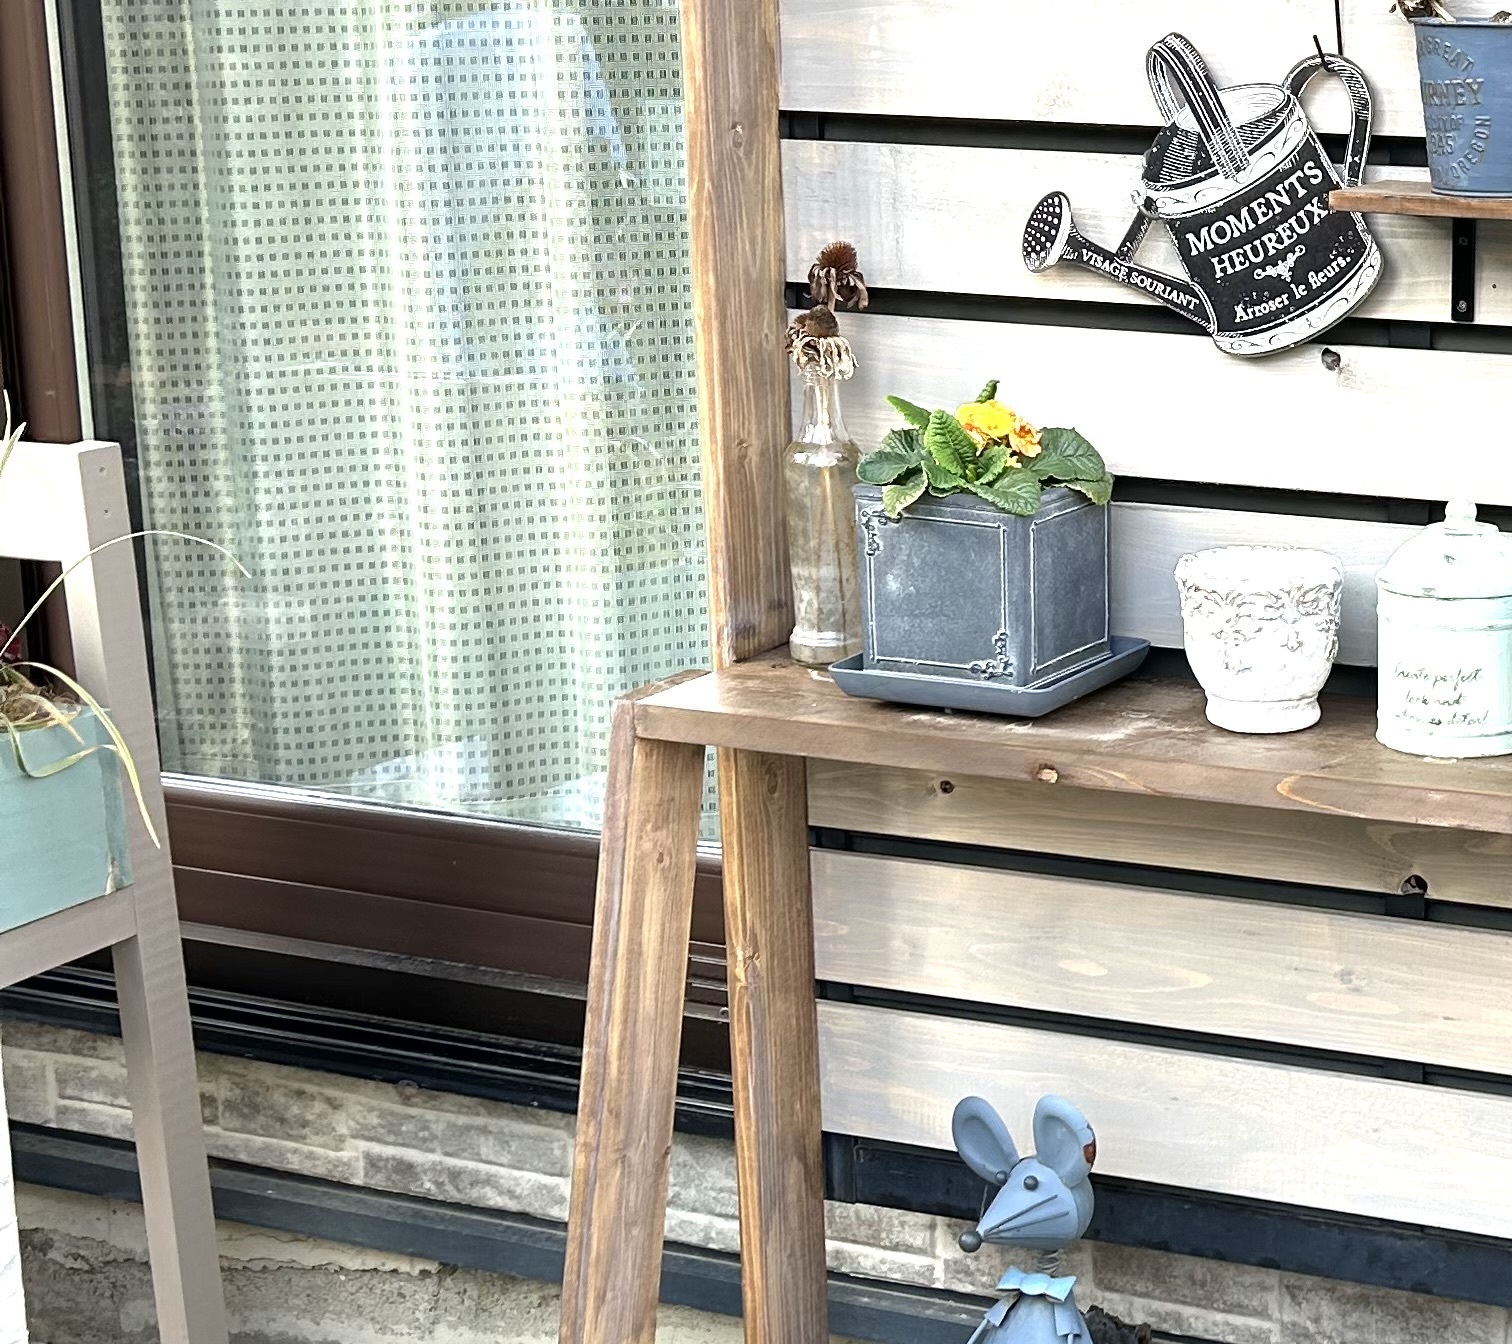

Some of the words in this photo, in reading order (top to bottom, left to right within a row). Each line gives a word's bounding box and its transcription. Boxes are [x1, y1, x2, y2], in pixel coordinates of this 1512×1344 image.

[1185, 160, 1323, 257] MOMENTS
[1210, 196, 1329, 278] HEUREUX
[1081, 248, 1129, 282] VISAGE
[1129, 272, 1200, 310] SOURIANT
[1233, 292, 1290, 323] Arroser
[1289, 283, 1308, 300] le
